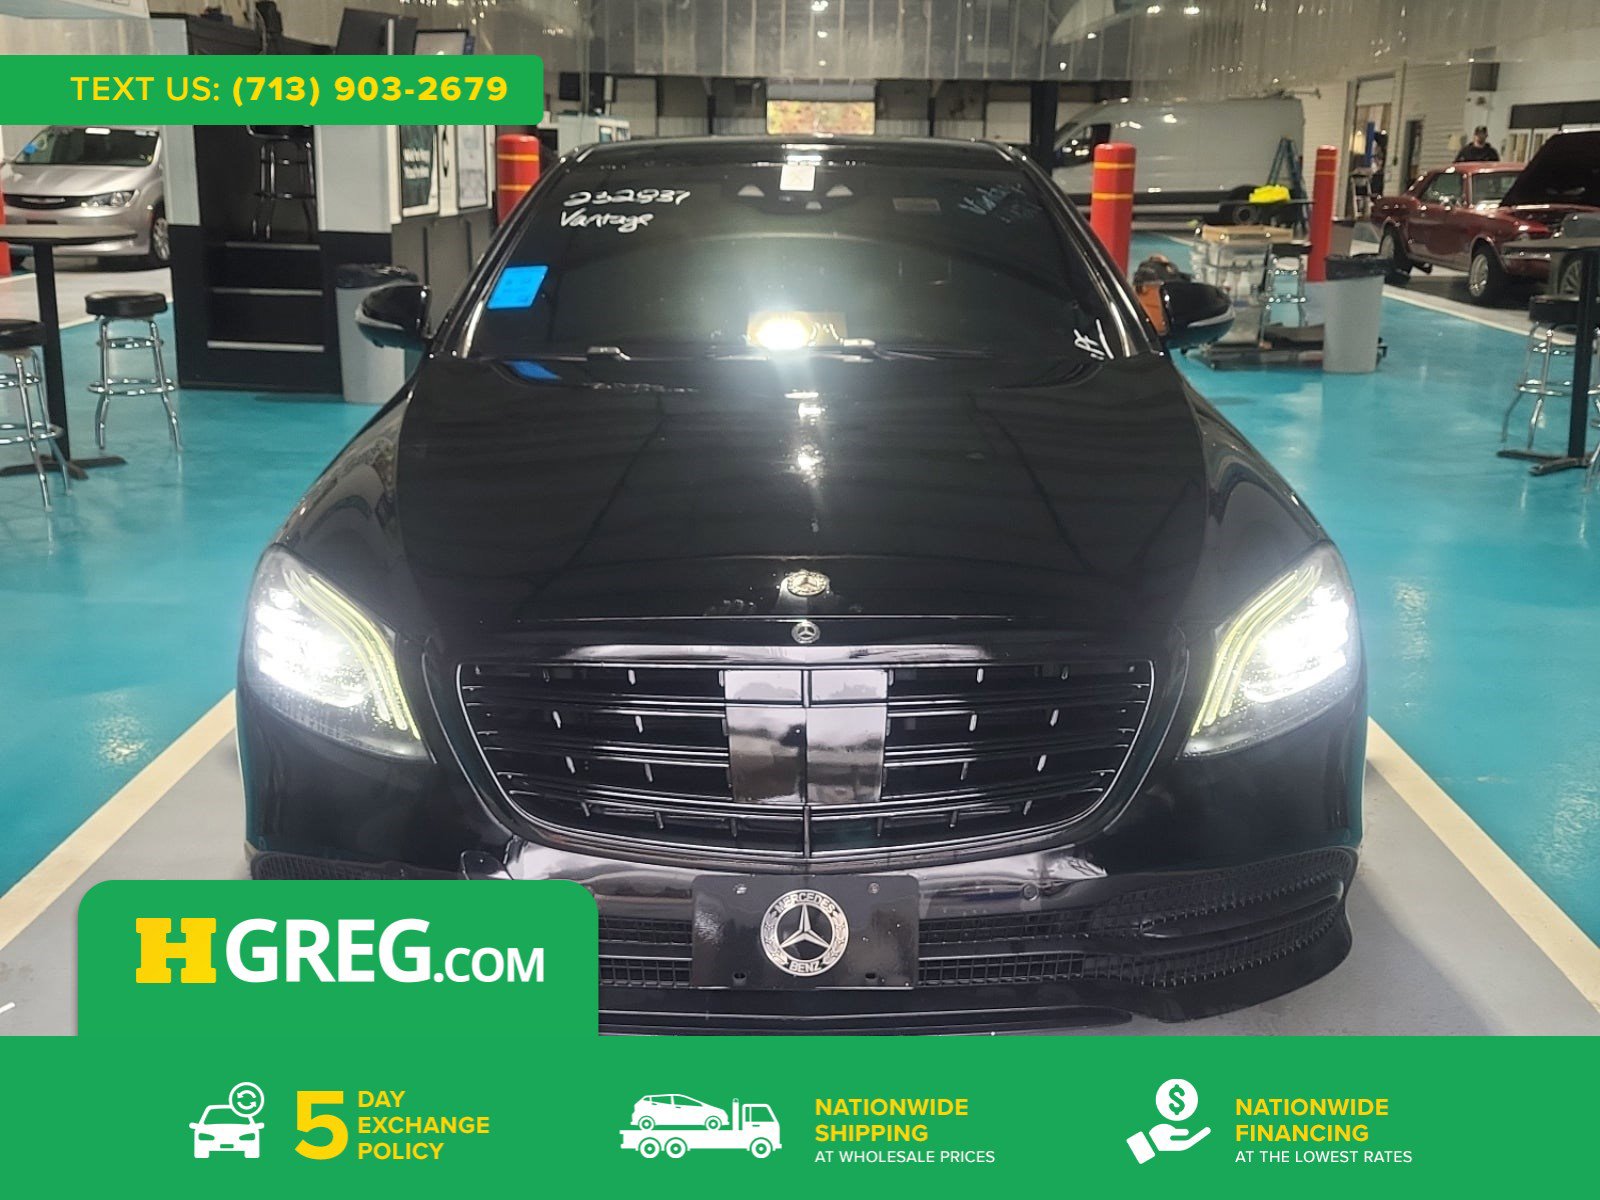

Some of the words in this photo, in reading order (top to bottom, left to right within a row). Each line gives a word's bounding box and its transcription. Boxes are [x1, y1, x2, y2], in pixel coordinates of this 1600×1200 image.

[560, 207, 654, 233] Vantage
[775, 892, 836, 914] MERCEDES
[789, 960, 822, 973] BENZ
